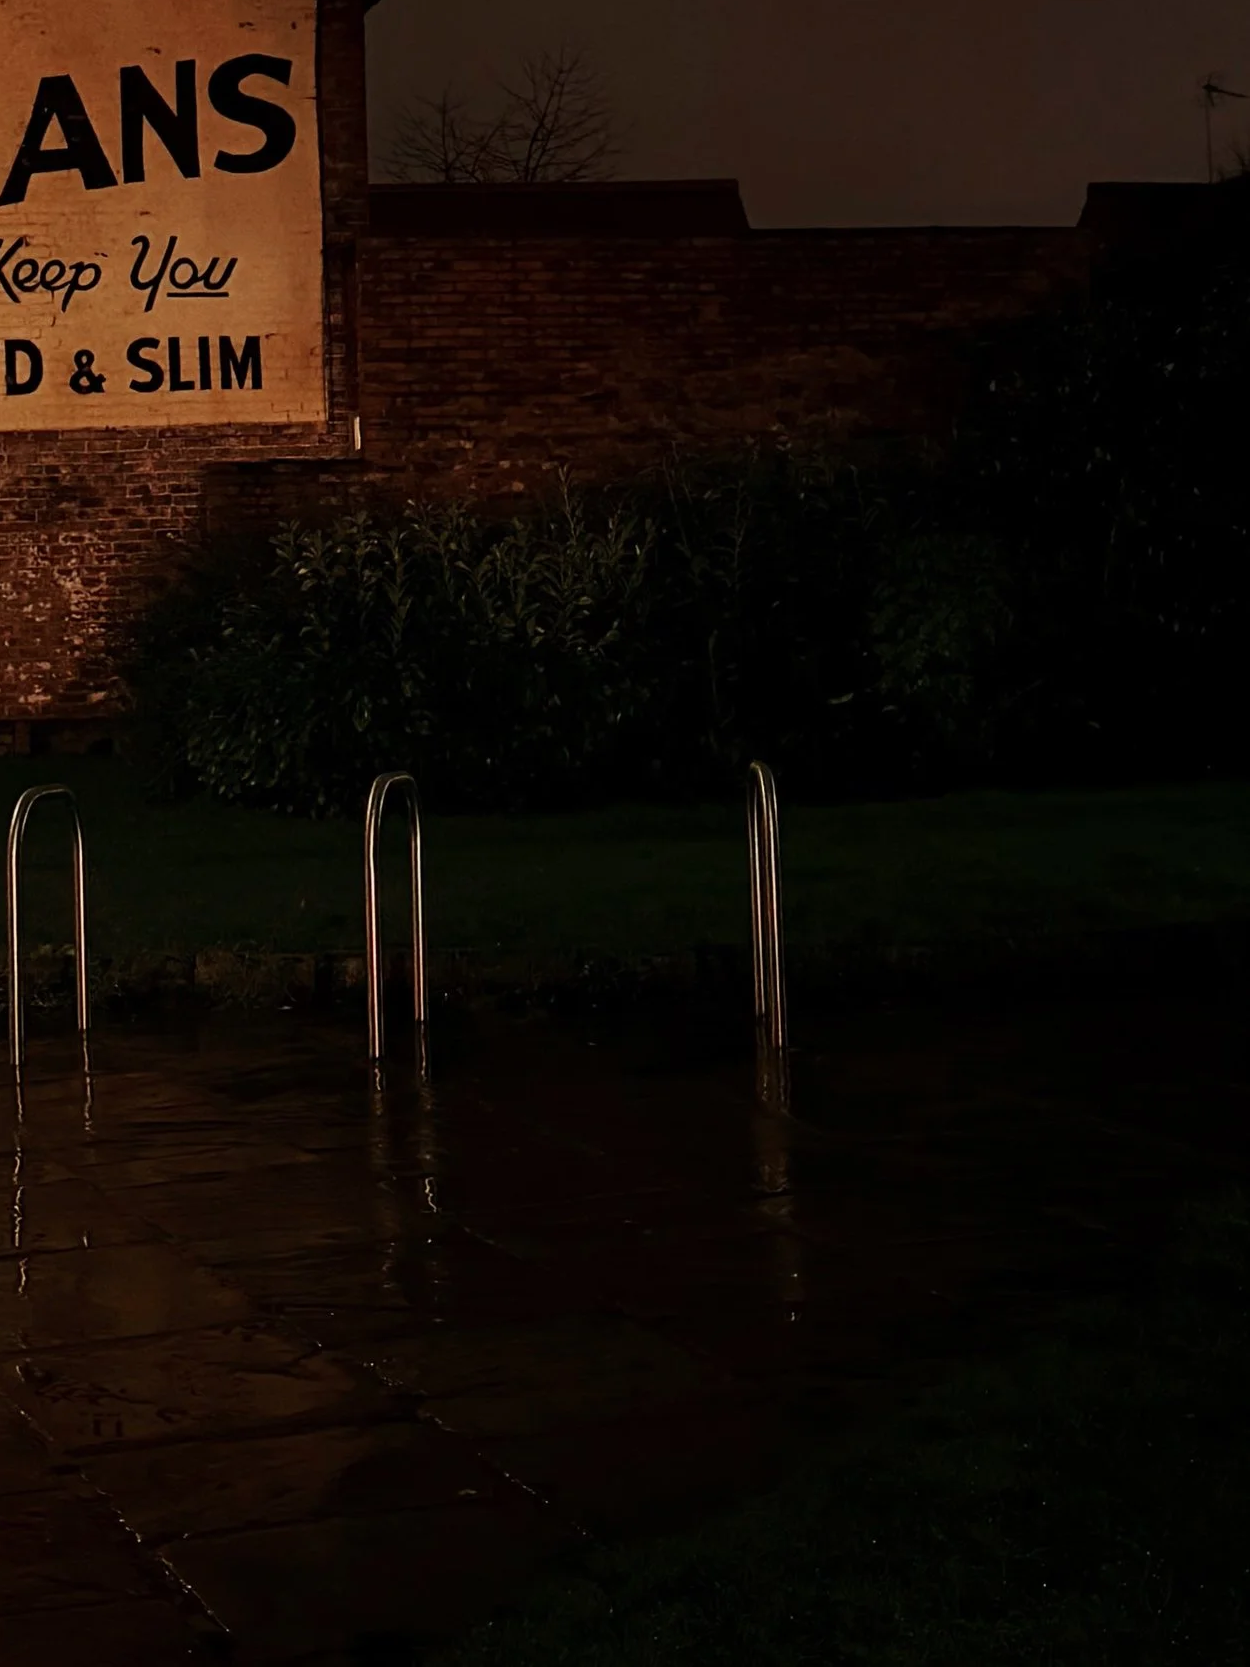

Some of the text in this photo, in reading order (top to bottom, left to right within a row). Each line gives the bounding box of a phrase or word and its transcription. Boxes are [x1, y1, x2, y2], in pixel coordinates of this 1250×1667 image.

[129, 235, 239, 312] You
[69, 348, 106, 395] &
[125, 335, 263, 392] SLIM
